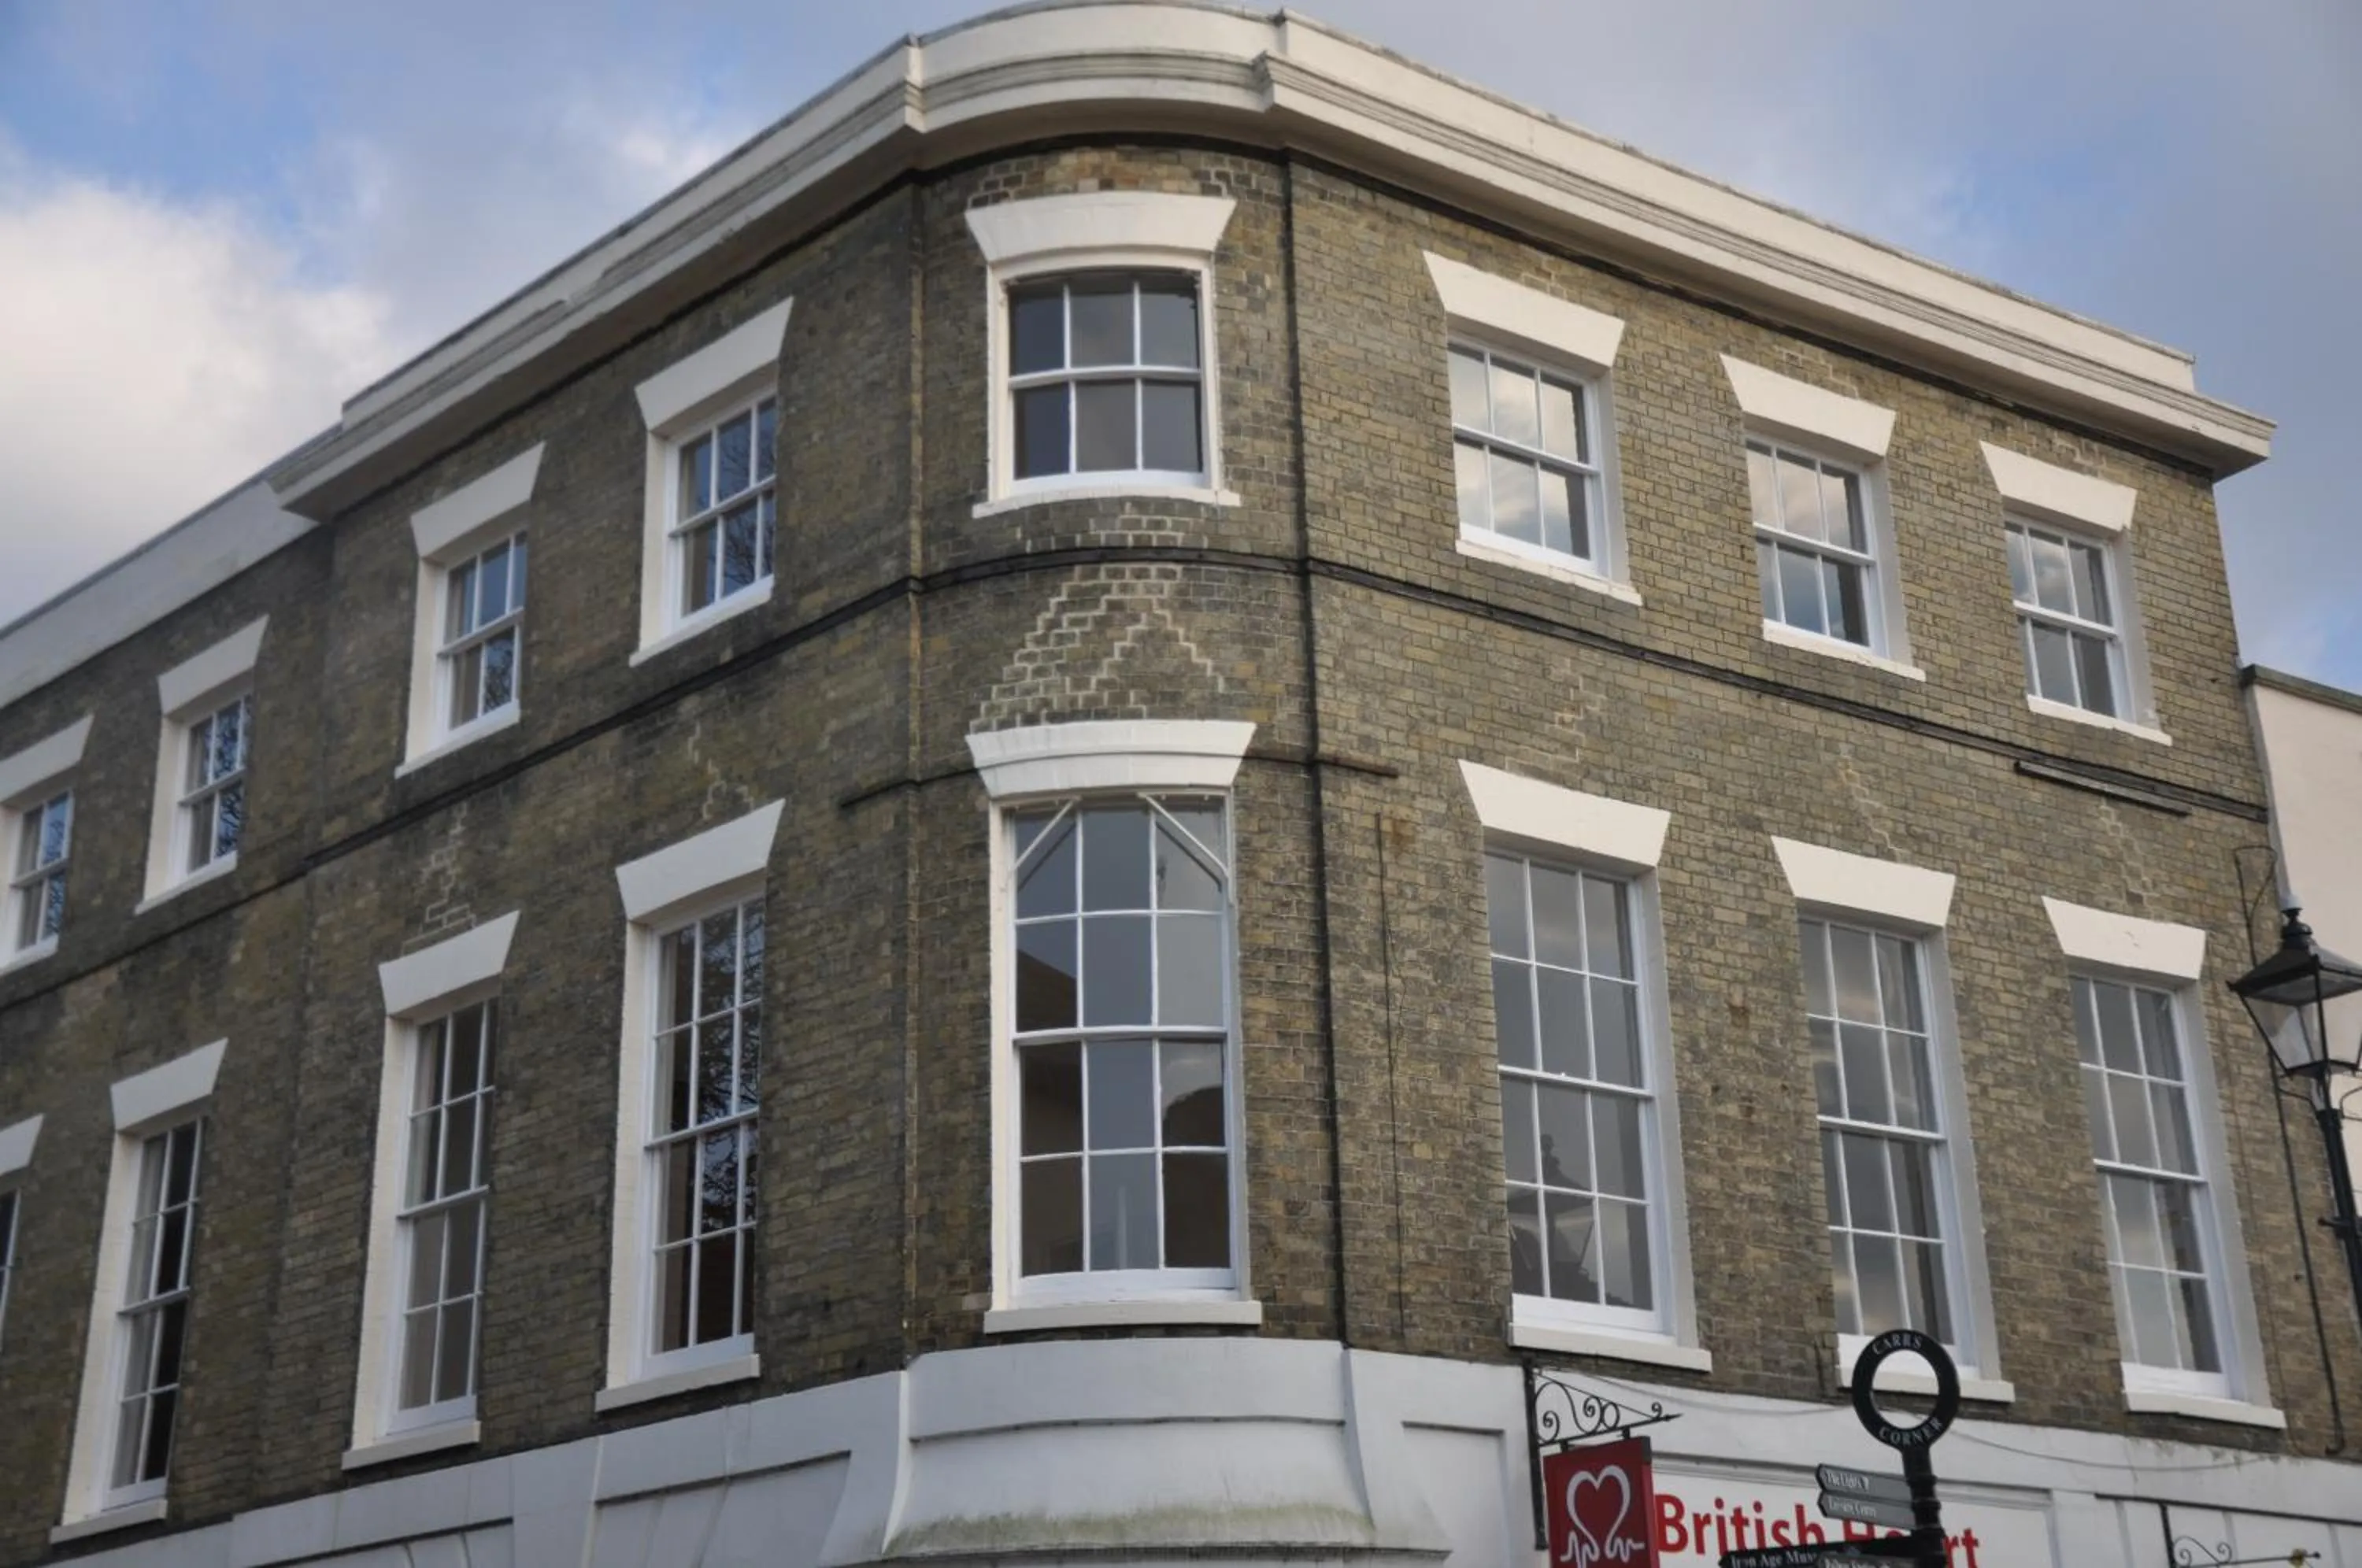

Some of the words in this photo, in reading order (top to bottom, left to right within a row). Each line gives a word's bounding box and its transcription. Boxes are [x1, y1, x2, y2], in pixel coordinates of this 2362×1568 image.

[1872, 1333, 1922, 1355] CARRS
[1879, 1417, 1942, 1445] CORNER
[1655, 1493, 1826, 1556] British
